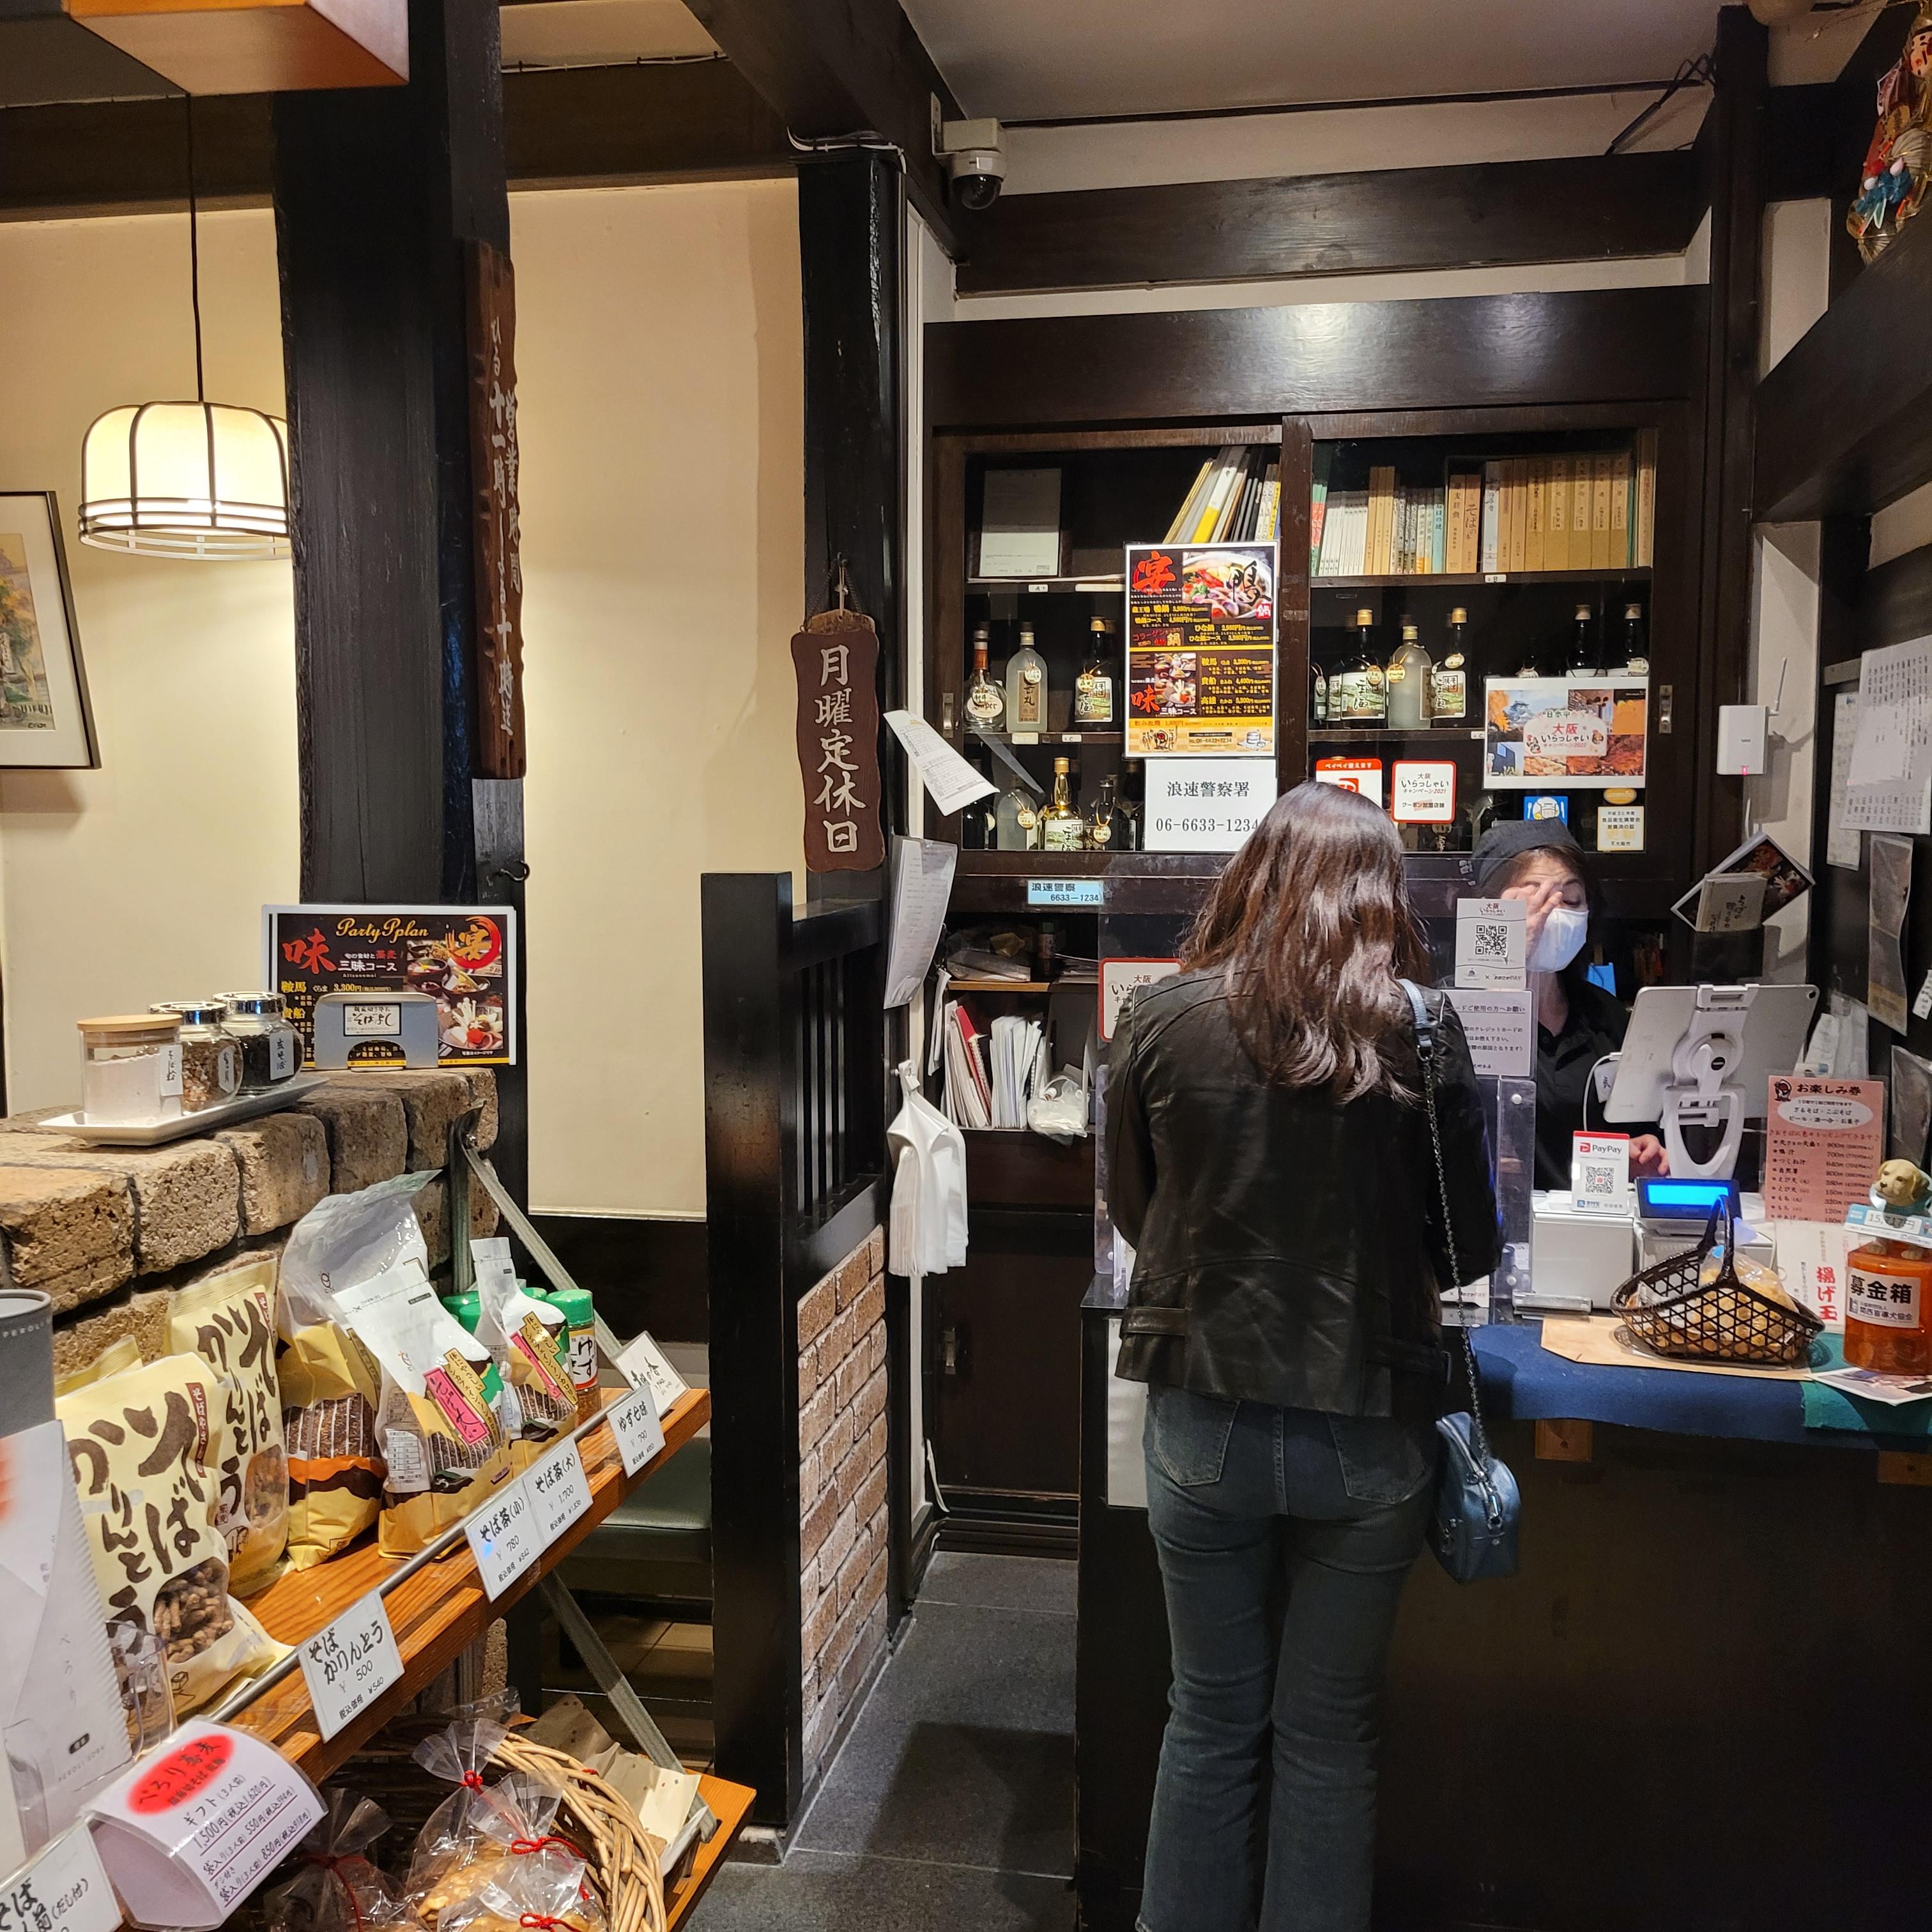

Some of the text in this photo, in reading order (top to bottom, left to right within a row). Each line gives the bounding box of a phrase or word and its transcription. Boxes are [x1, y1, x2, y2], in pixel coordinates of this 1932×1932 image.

[1132, 551, 1176, 595] 宴
[1131, 685, 1160, 713] 味
[1552, 723, 1578, 735] 大阪
[813, 644, 866, 852] 月曜定休日
[1167, 781, 1250, 798] 浪速警察署
[1401, 779, 1449, 788] いらっしゃい
[1156, 818, 1259, 832] 06-6633-1234
[1031, 882, 1075, 892] 浪速警察
[335, 917, 429, 944] Party Pplan
[457, 924, 491, 961] 宴
[282, 928, 337, 974] 味
[337, 960, 397, 972] 三昧コース
[1133, 974, 1152, 984] 大阪
[281, 981, 307, 993] 鞍馬
[334, 983, 362, 992] 3,300円
[1797, 1084, 1862, 1096] お楽しみ券
[1592, 1144, 1622, 1154] PayPay
[1851, 1275, 1912, 1304] 募金箱
[1860, 1307, 1913, 1321] 関西盲導犬協会
[617, 1400, 648, 1432] ゆず七味
[535, 1453, 575, 1493] そば茶(大)
[480, 1497, 525, 1543] そば茶(小)
[506, 1535, 519, 1551] 780
[309, 1627, 339, 1663] そば
[324, 1620, 383, 1685] かりんとう
[356, 1660, 373, 1681] 500
[339, 1694, 364, 1720] 税込価格
[183, 1797, 217, 1826] ギフト
[218, 1774, 246, 1800] (3人前)
